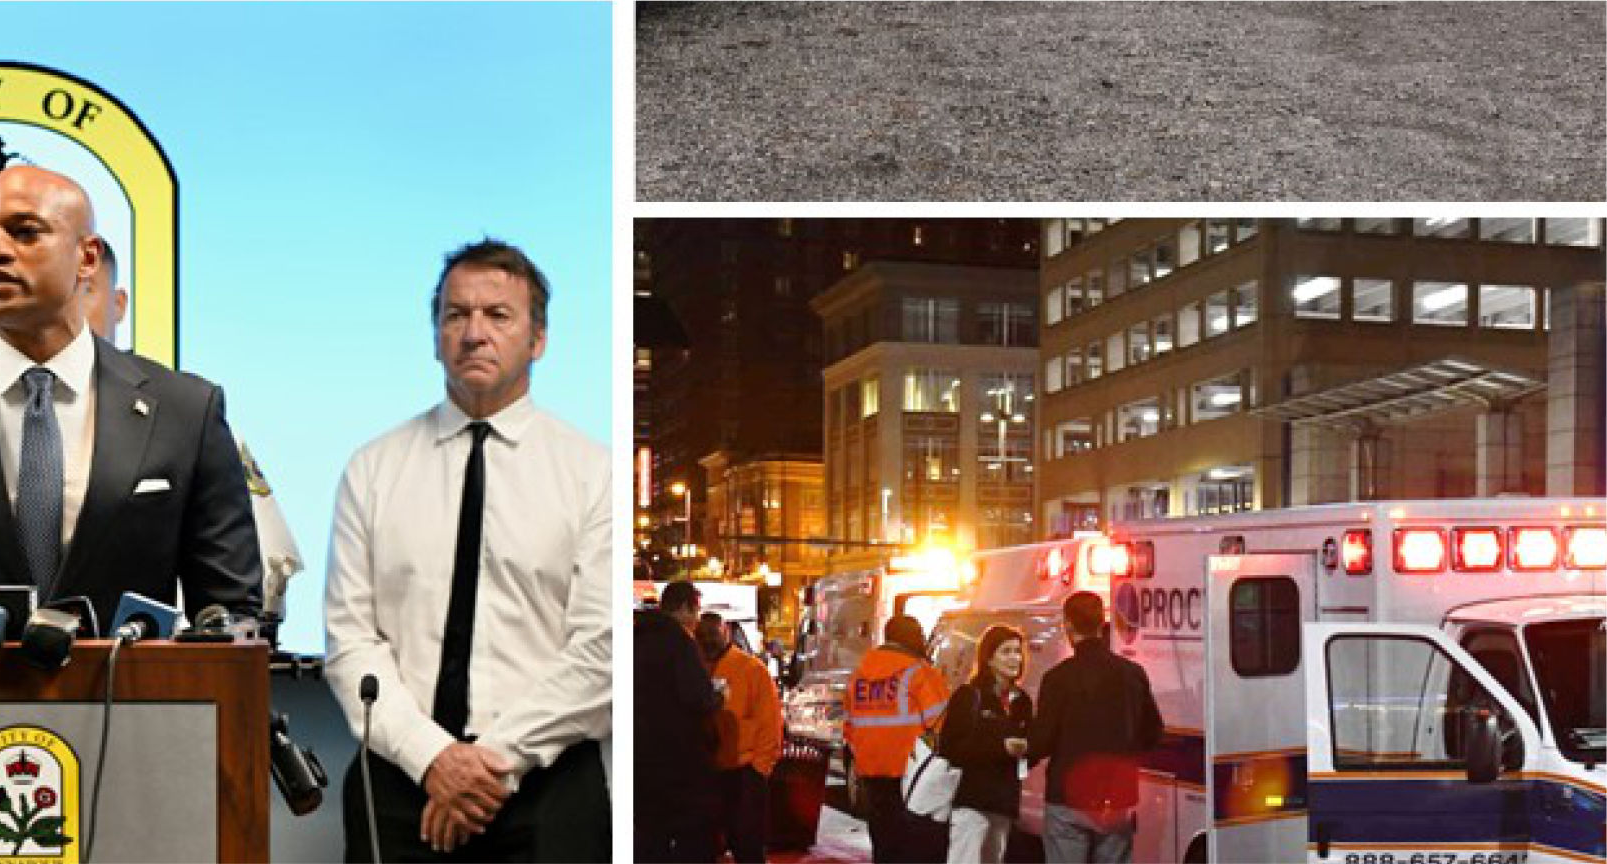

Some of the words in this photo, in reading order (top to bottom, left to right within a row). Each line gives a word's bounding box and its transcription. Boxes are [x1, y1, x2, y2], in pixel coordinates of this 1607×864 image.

[42, 88, 102, 131] OF
[1140, 586, 1207, 631] PROC
[855, 675, 899, 703] EMS
